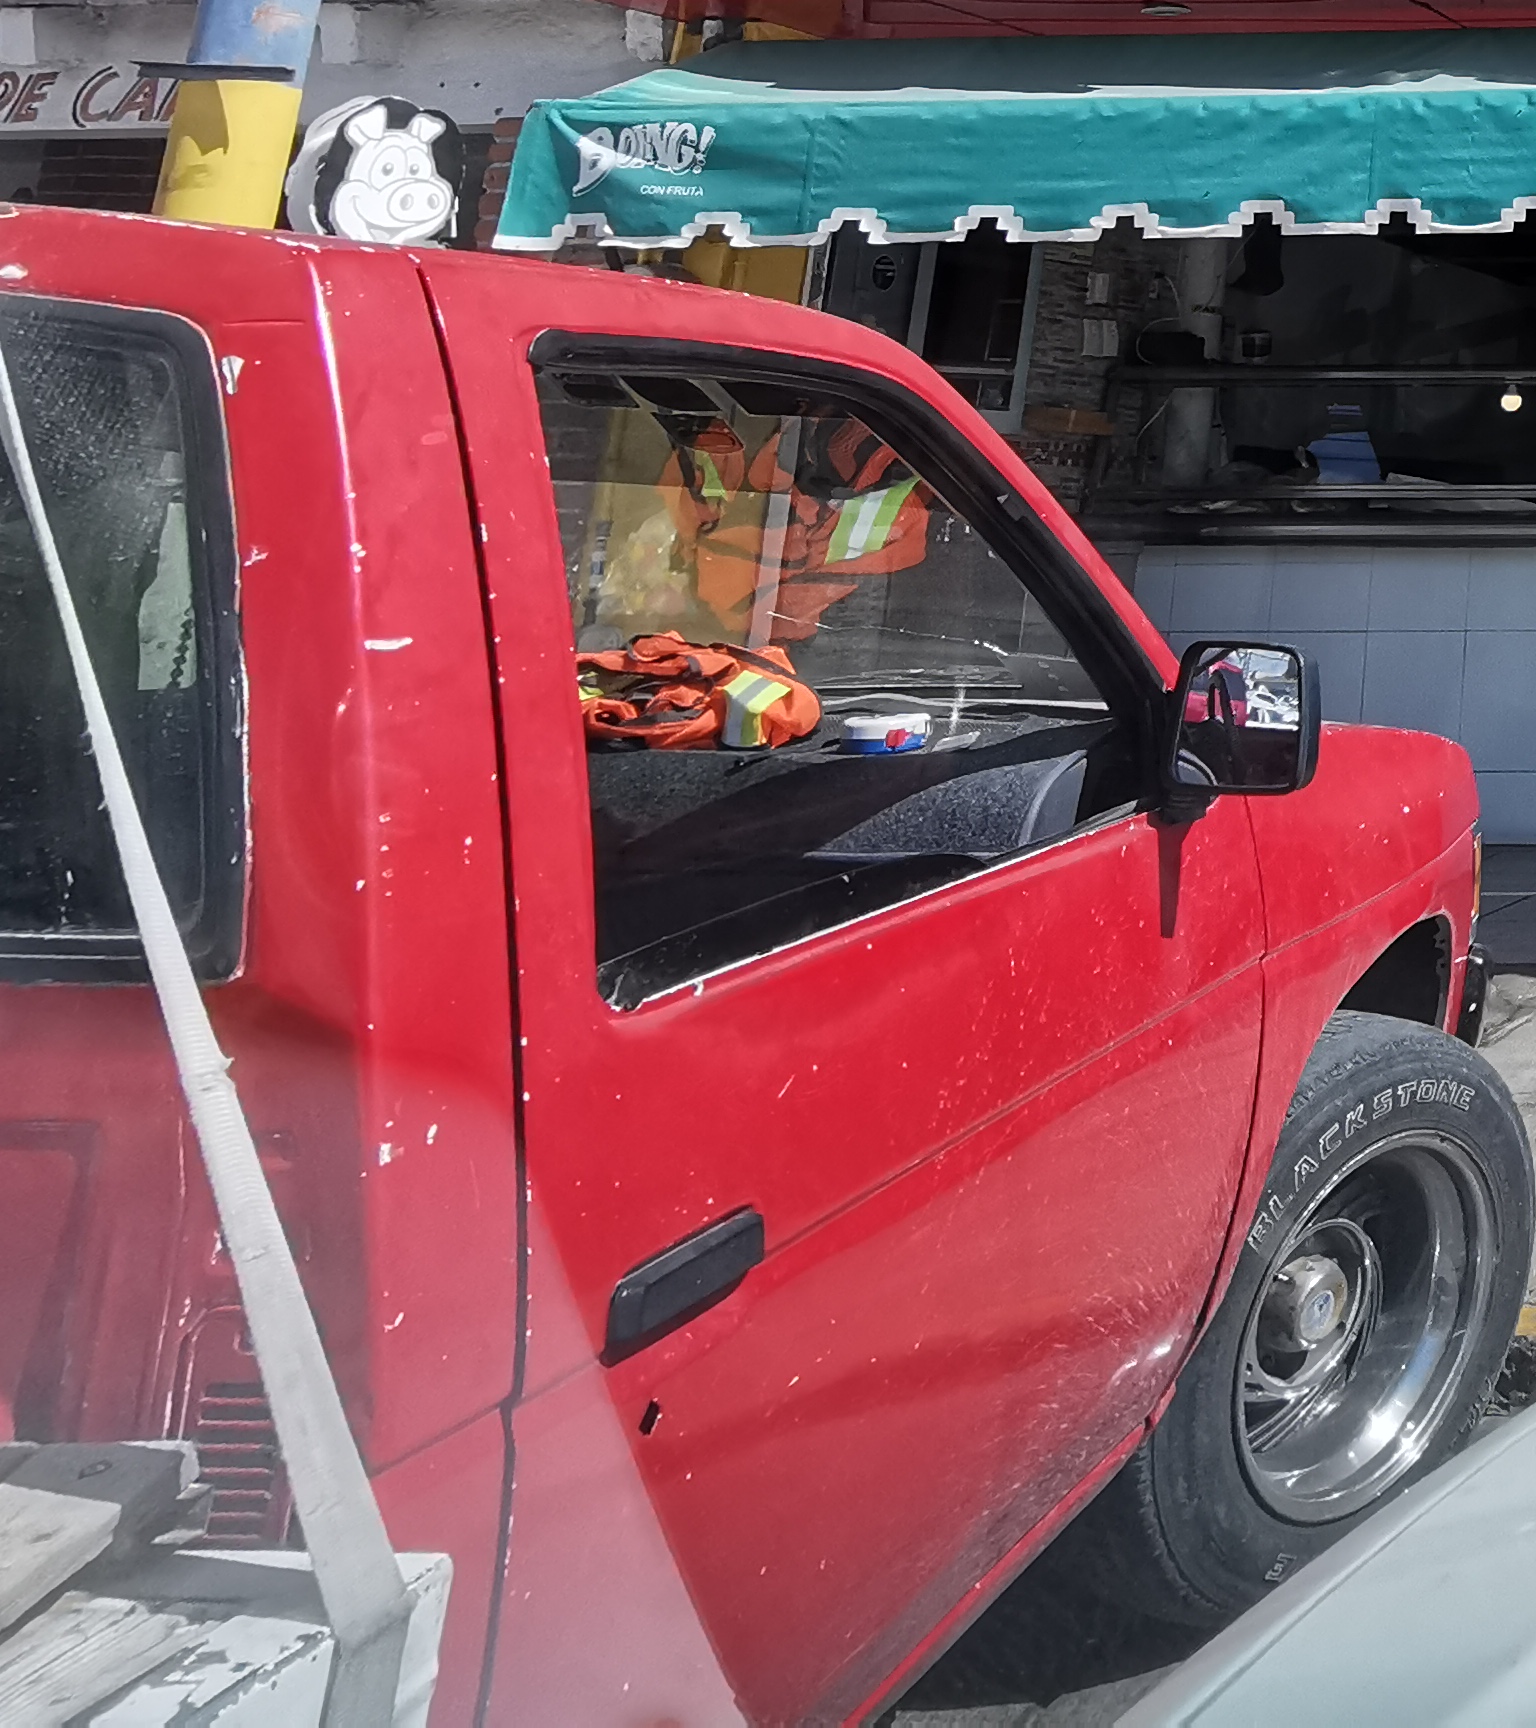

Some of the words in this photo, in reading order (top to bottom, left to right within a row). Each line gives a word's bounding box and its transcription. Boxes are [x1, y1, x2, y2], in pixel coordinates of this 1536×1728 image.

[572, 122, 716, 197] BOING!
[640, 184, 664, 196] CON
[666, 185, 704, 197] FRUTA
